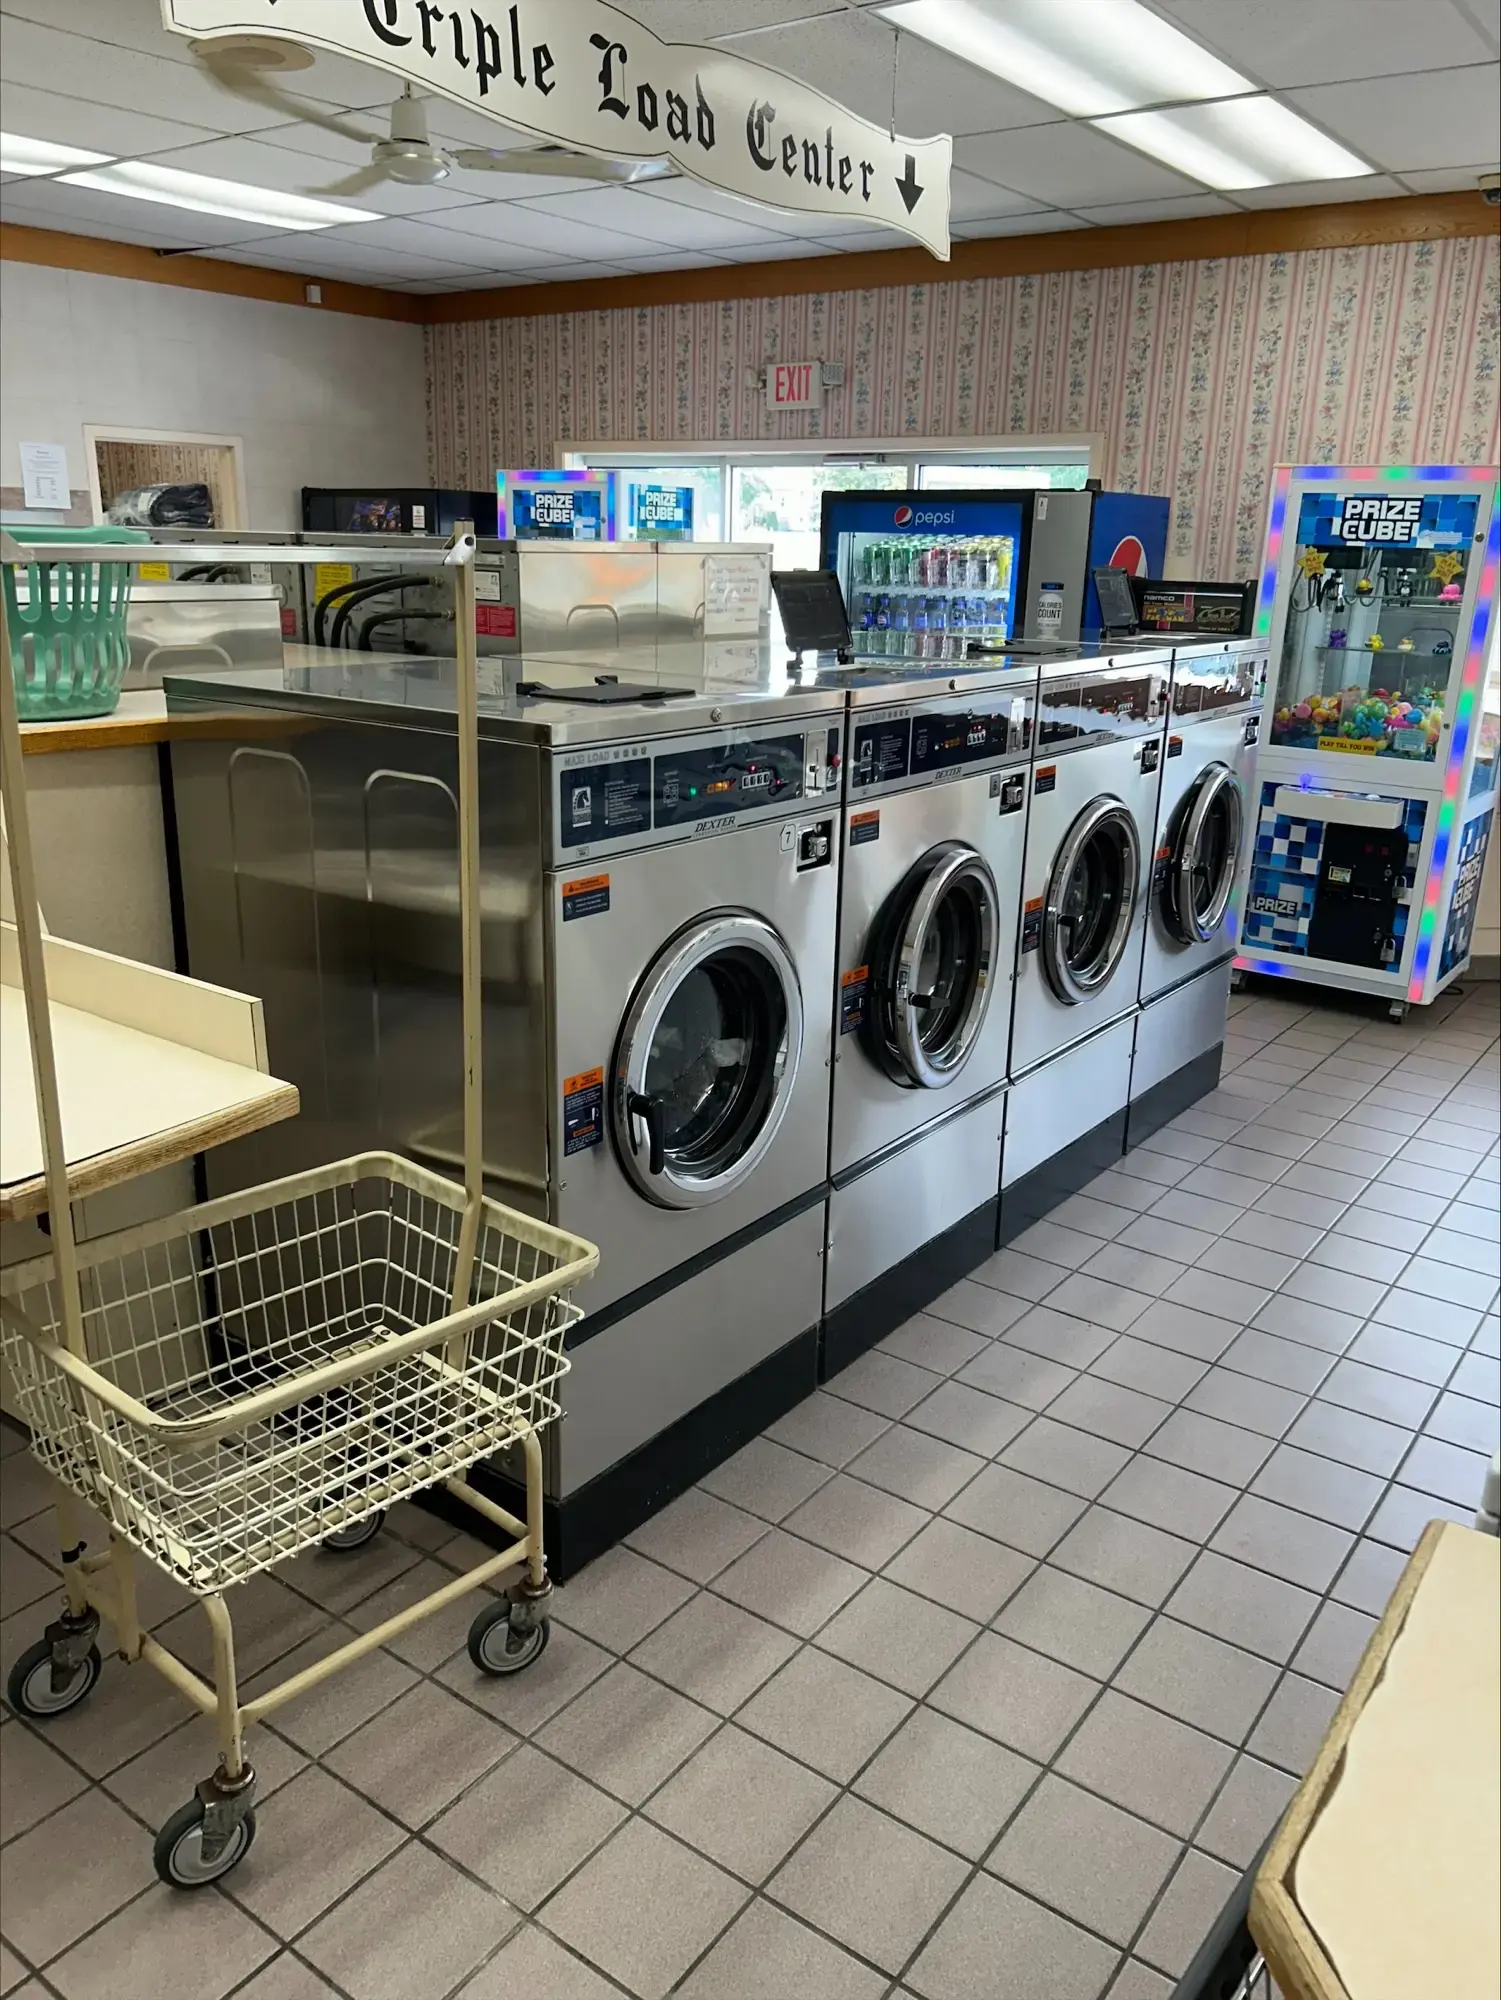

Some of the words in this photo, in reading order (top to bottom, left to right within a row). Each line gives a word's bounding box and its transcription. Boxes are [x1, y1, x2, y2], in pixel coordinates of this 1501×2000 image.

[589, 33, 715, 151] Load
[746, 98, 875, 202] Center
[775, 364, 812, 402] EXIT
[536, 494, 573, 508] PRIZE
[645, 491, 677, 506] PRIZE
[537, 508, 571, 523] CUBE
[645, 506, 675, 521] CUBE
[1345, 500, 1421, 521] PRIZE
[915, 510, 955, 527] pepsi
[1342, 520, 1411, 542] CUBE
[1038, 601, 1062, 609] CALORIES
[1143, 594, 1175, 602] namco
[1038, 609, 1062, 619] COUNT
[935, 766, 962, 780] DEXTER
[694, 815, 736, 833] DEXTER
[785, 831, 791, 844] 7
[1256, 896, 1296, 914] PRIZE
